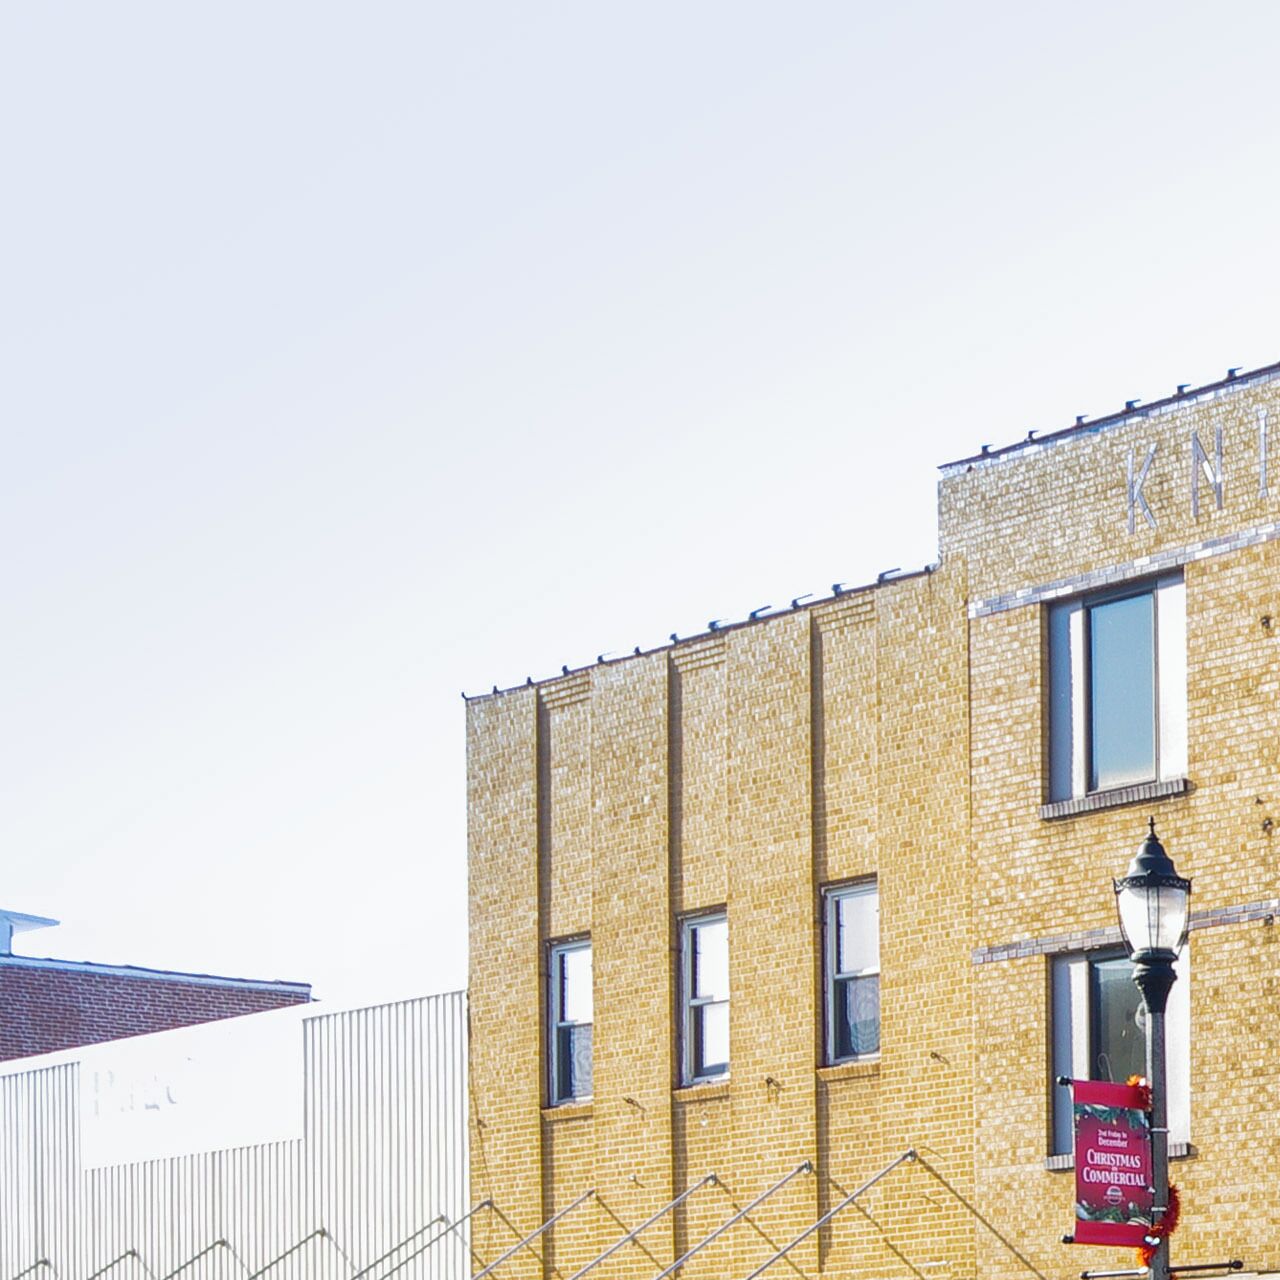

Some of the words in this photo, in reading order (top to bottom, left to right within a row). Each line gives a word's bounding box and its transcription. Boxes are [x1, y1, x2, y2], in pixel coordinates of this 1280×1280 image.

[1098, 1136, 1129, 1148] December
[1087, 1149, 1141, 1168] CHRISTMAS
[1083, 1167, 1146, 1186] COMMERCIAL
